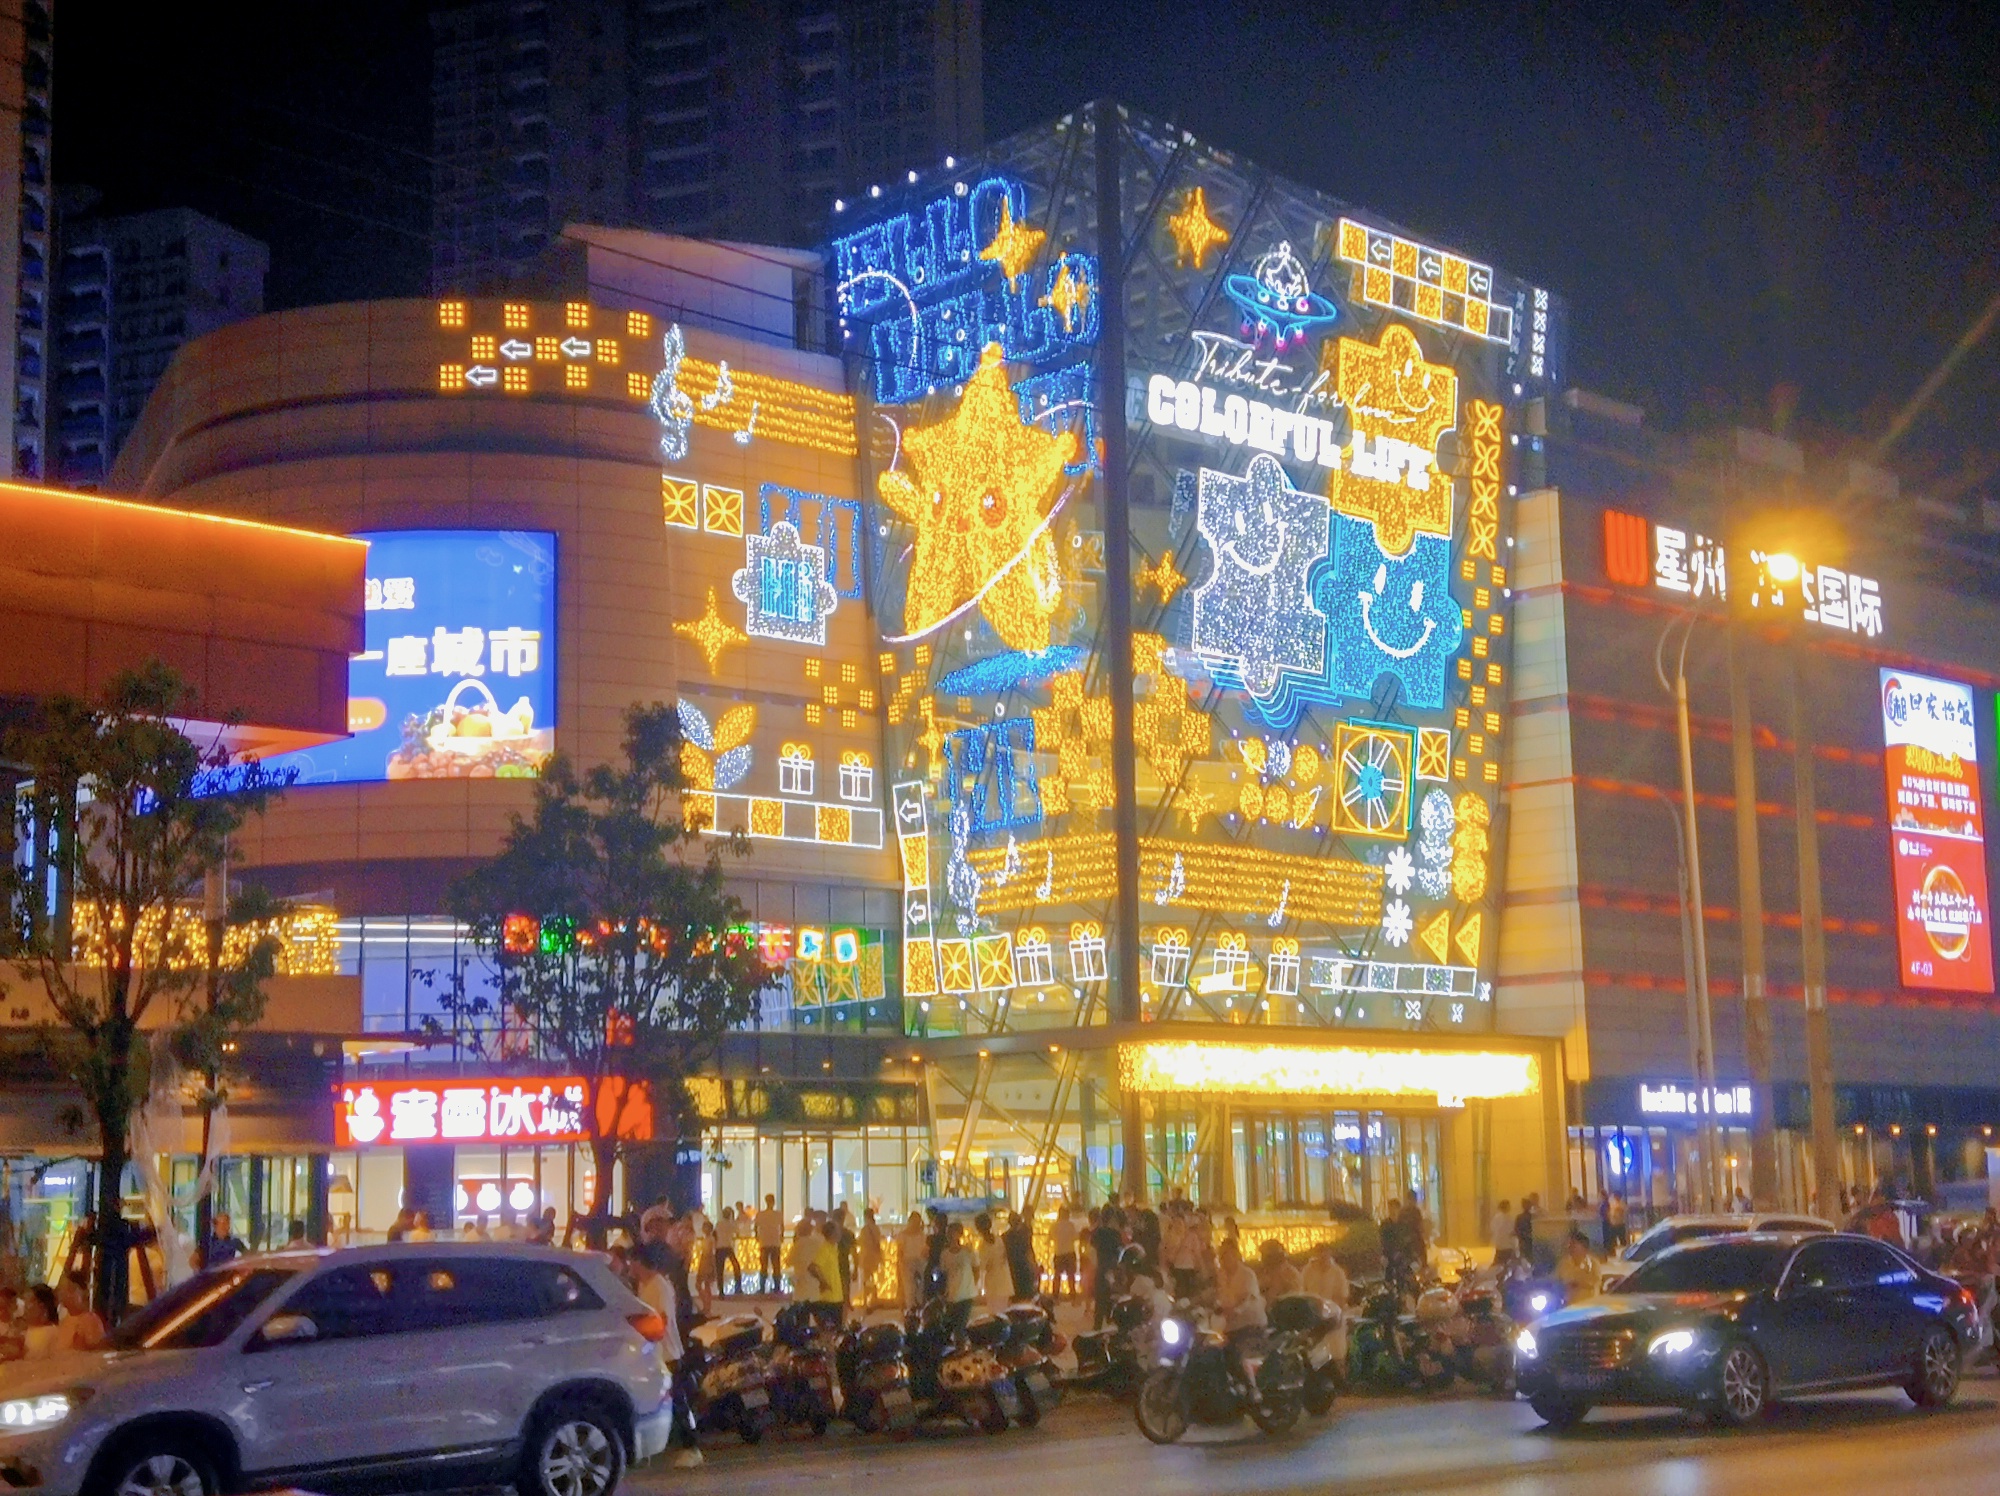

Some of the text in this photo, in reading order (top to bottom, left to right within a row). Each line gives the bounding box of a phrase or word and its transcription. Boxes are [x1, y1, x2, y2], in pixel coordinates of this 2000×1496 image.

[1192, 330, 1293, 394] Tribute
[1149, 373, 1343, 469] COLORFUL
[1350, 429, 1434, 492] LIFE
[349, 626, 541, 677] 一座城市
